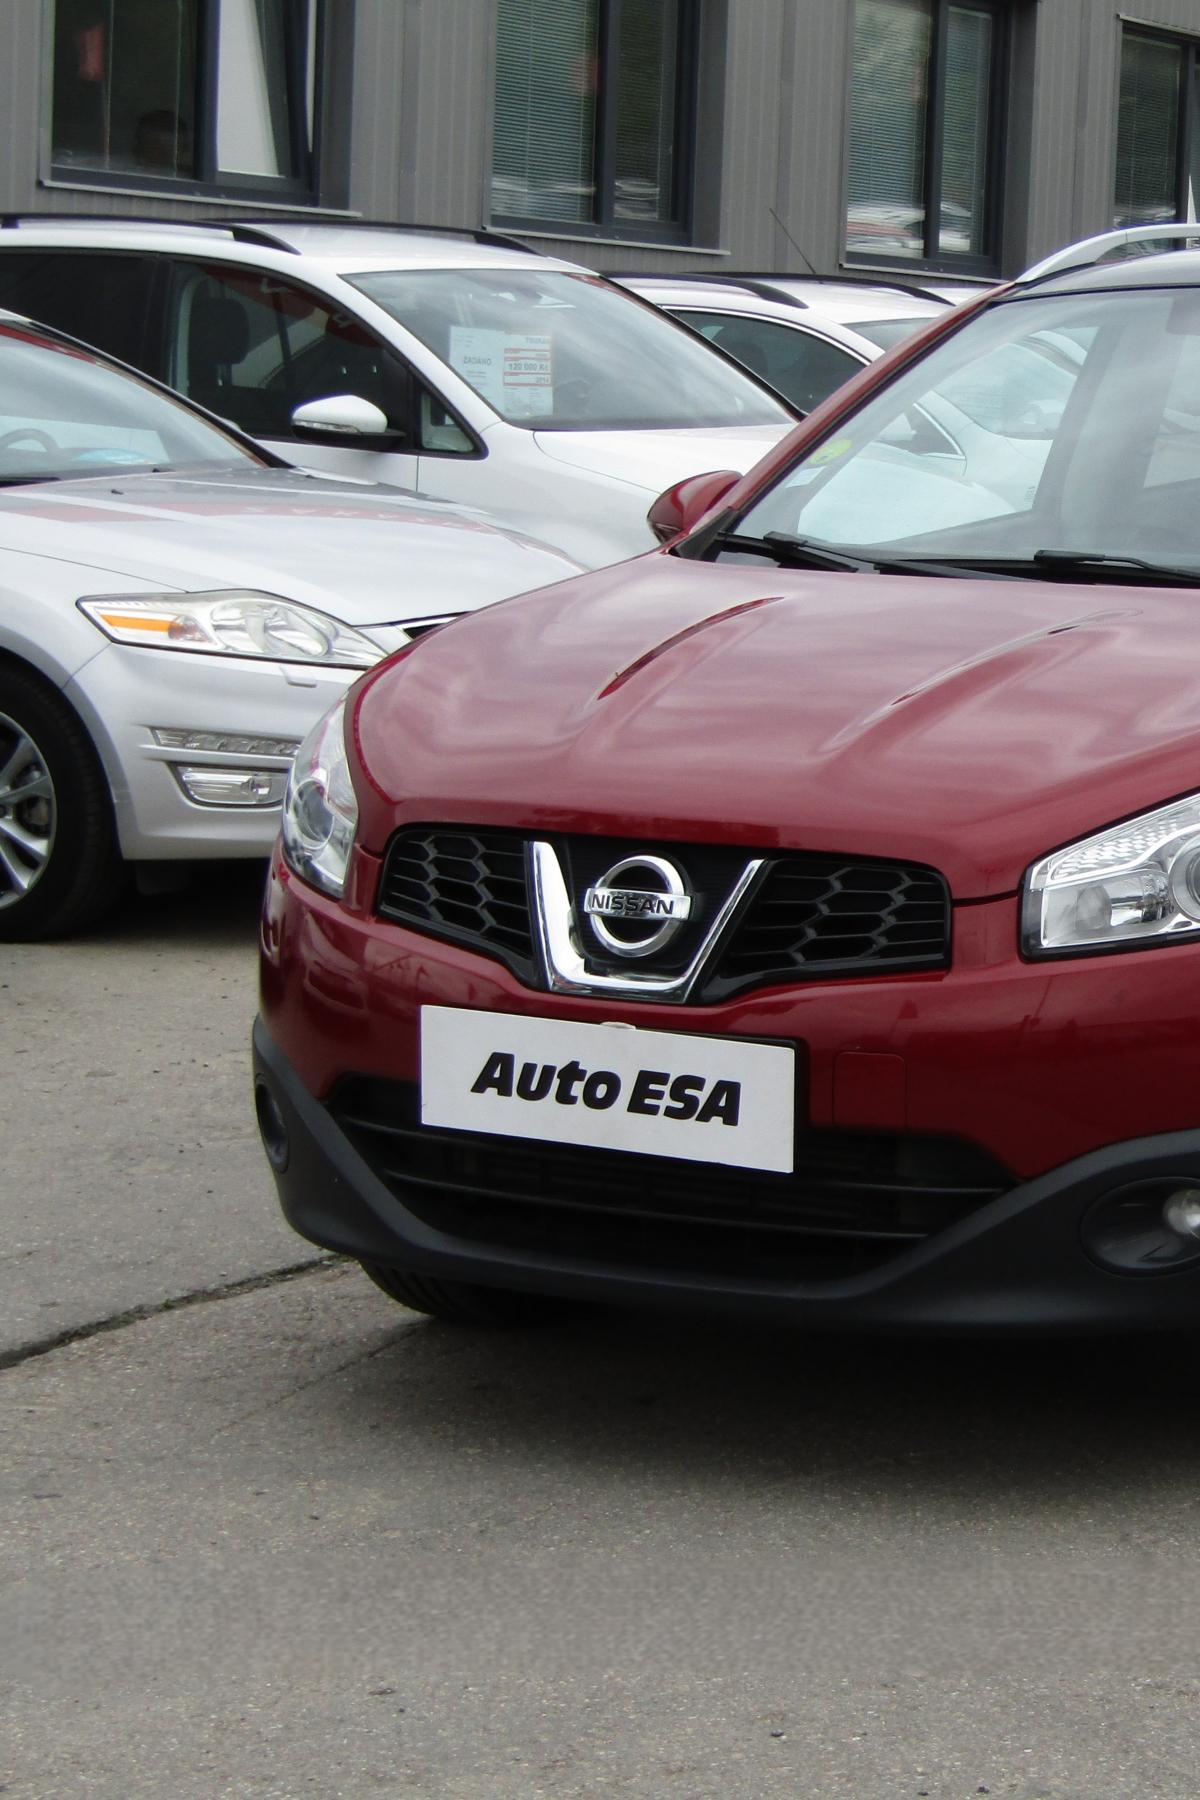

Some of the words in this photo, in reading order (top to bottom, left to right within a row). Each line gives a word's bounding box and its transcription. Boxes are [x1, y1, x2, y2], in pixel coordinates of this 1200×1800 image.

[591, 893, 674, 915] NISSAN
[471, 1051, 622, 1110] Auto
[626, 1069, 741, 1127] ESA
